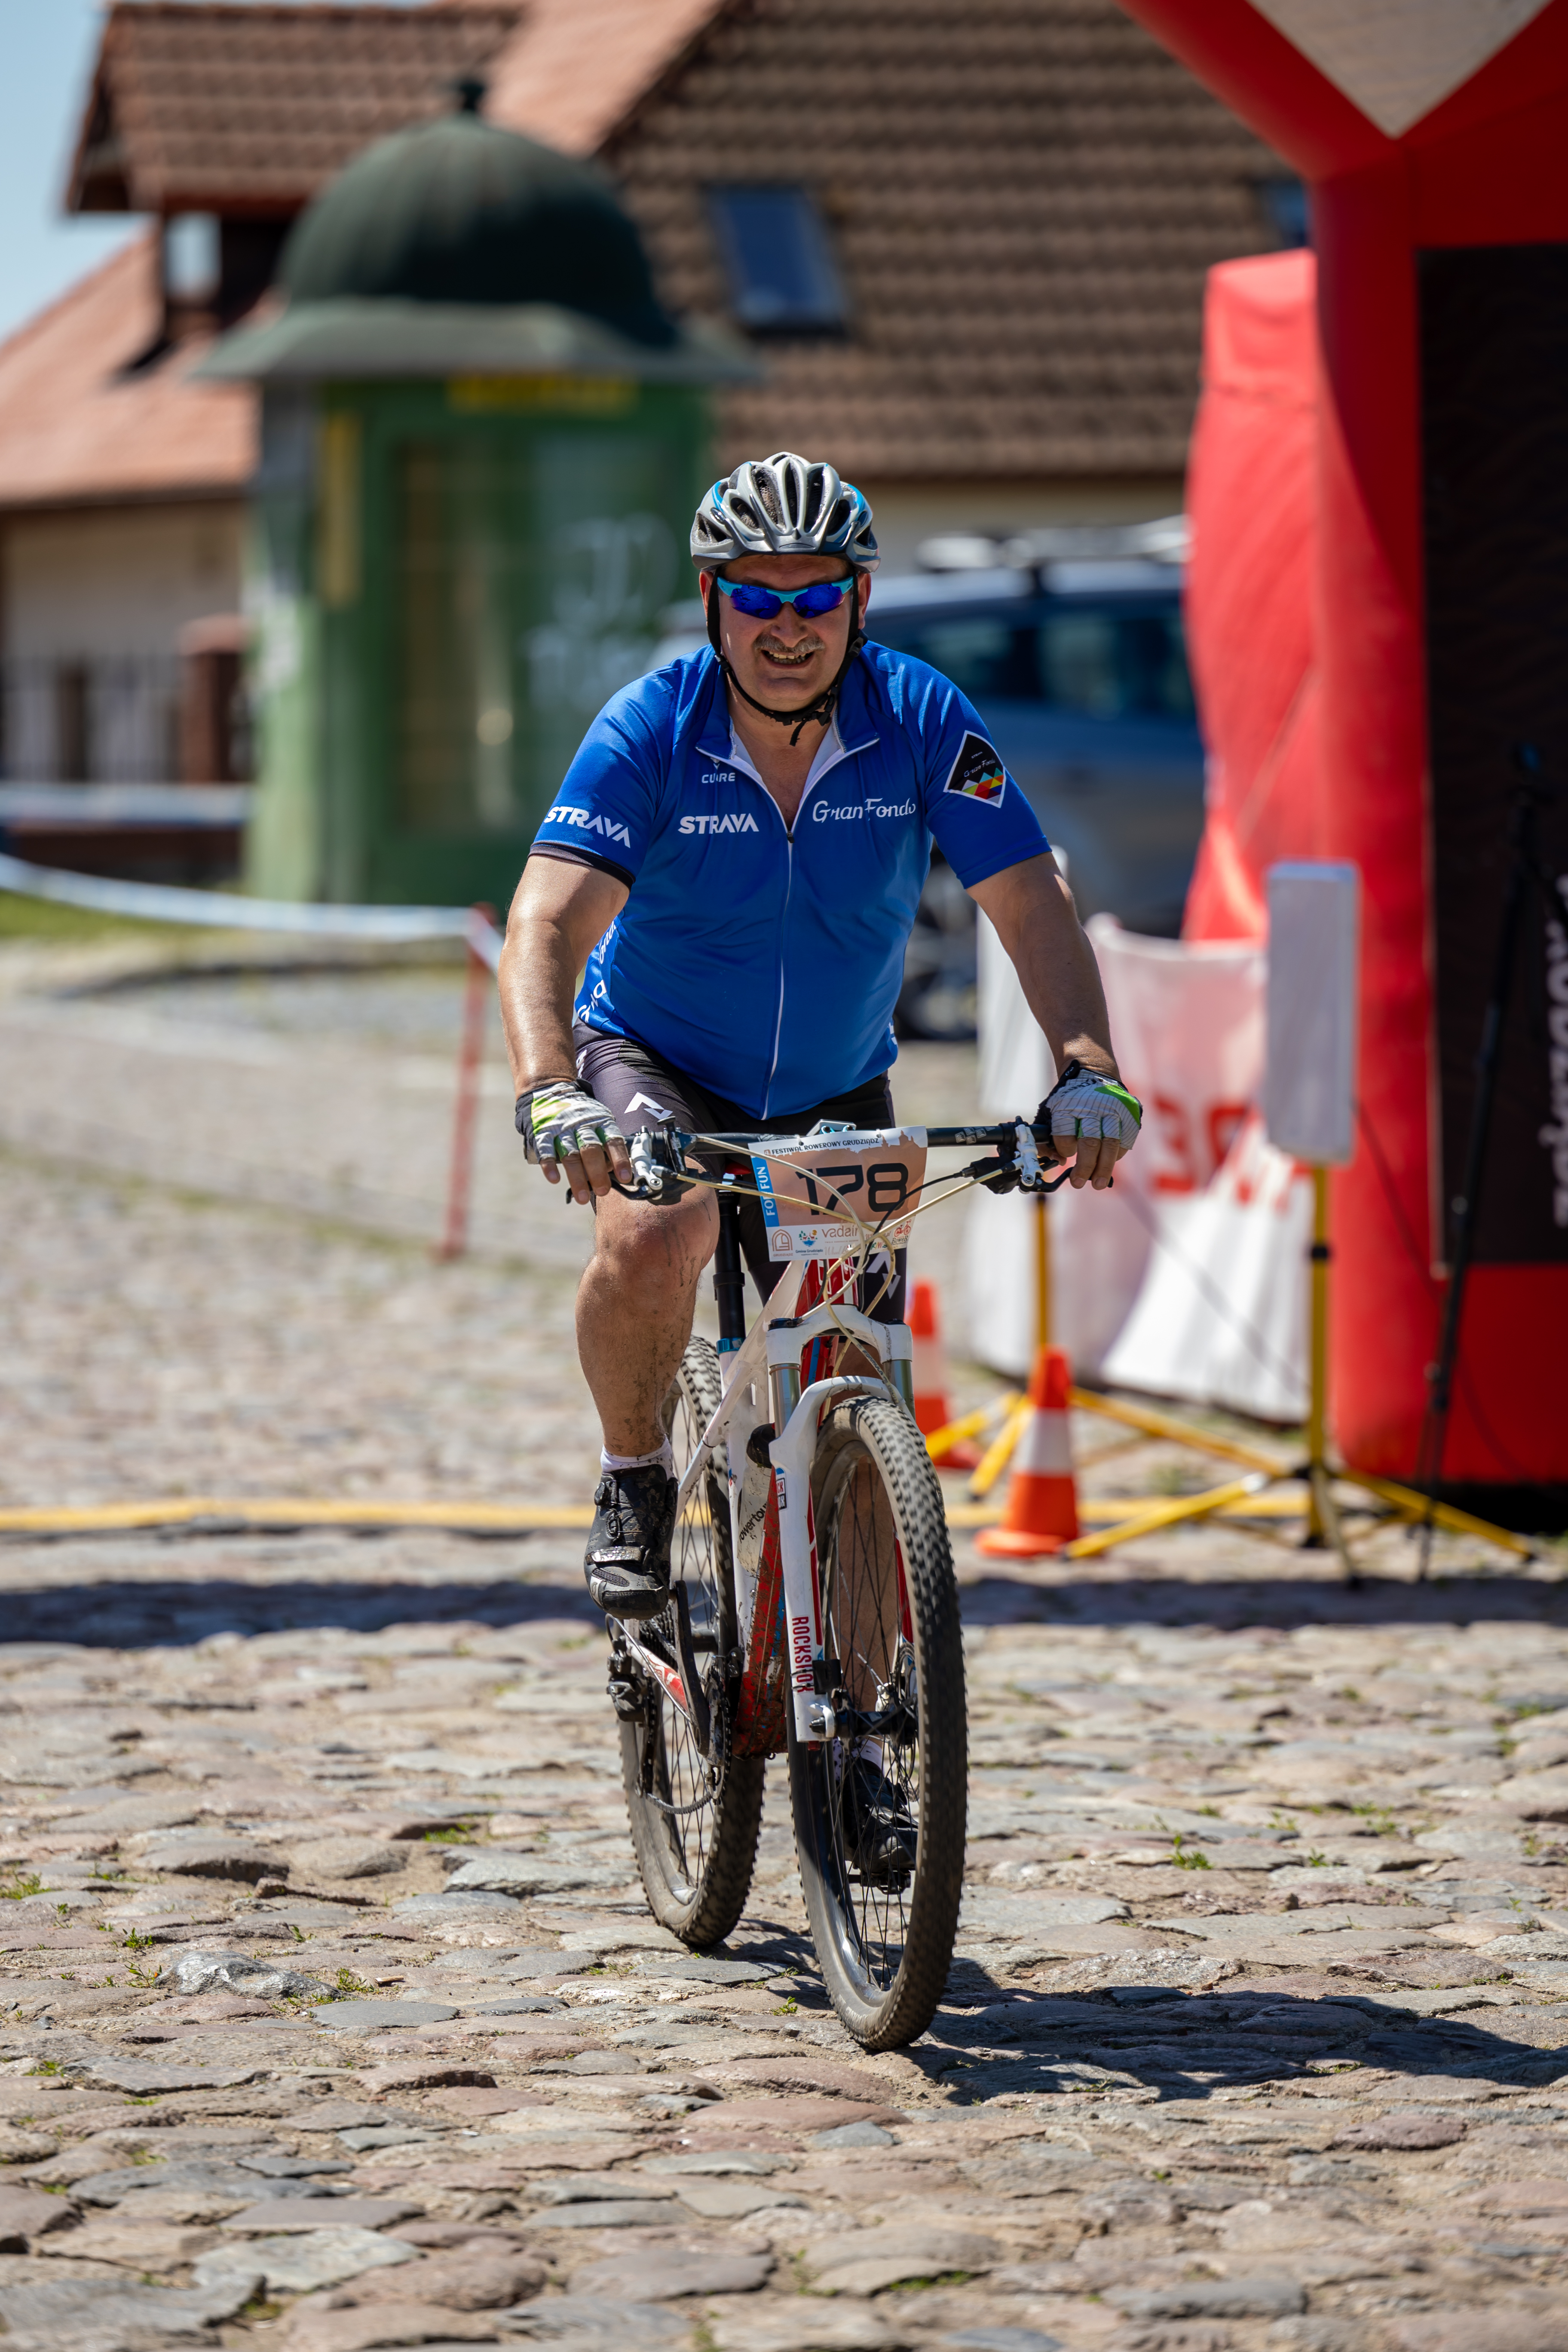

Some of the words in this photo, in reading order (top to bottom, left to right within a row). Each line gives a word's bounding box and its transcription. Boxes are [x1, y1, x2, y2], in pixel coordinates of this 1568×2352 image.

[701, 773, 735, 783] CURE
[544, 805, 631, 848] STRAVA
[678, 813, 759, 834] STRAVA
[772, 1146, 803, 1155] FESTIWAL
[804, 1141, 841, 1151] ROWEROWY
[756, 1167, 770, 1189] FUN
[795, 1163, 909, 1216] 178
